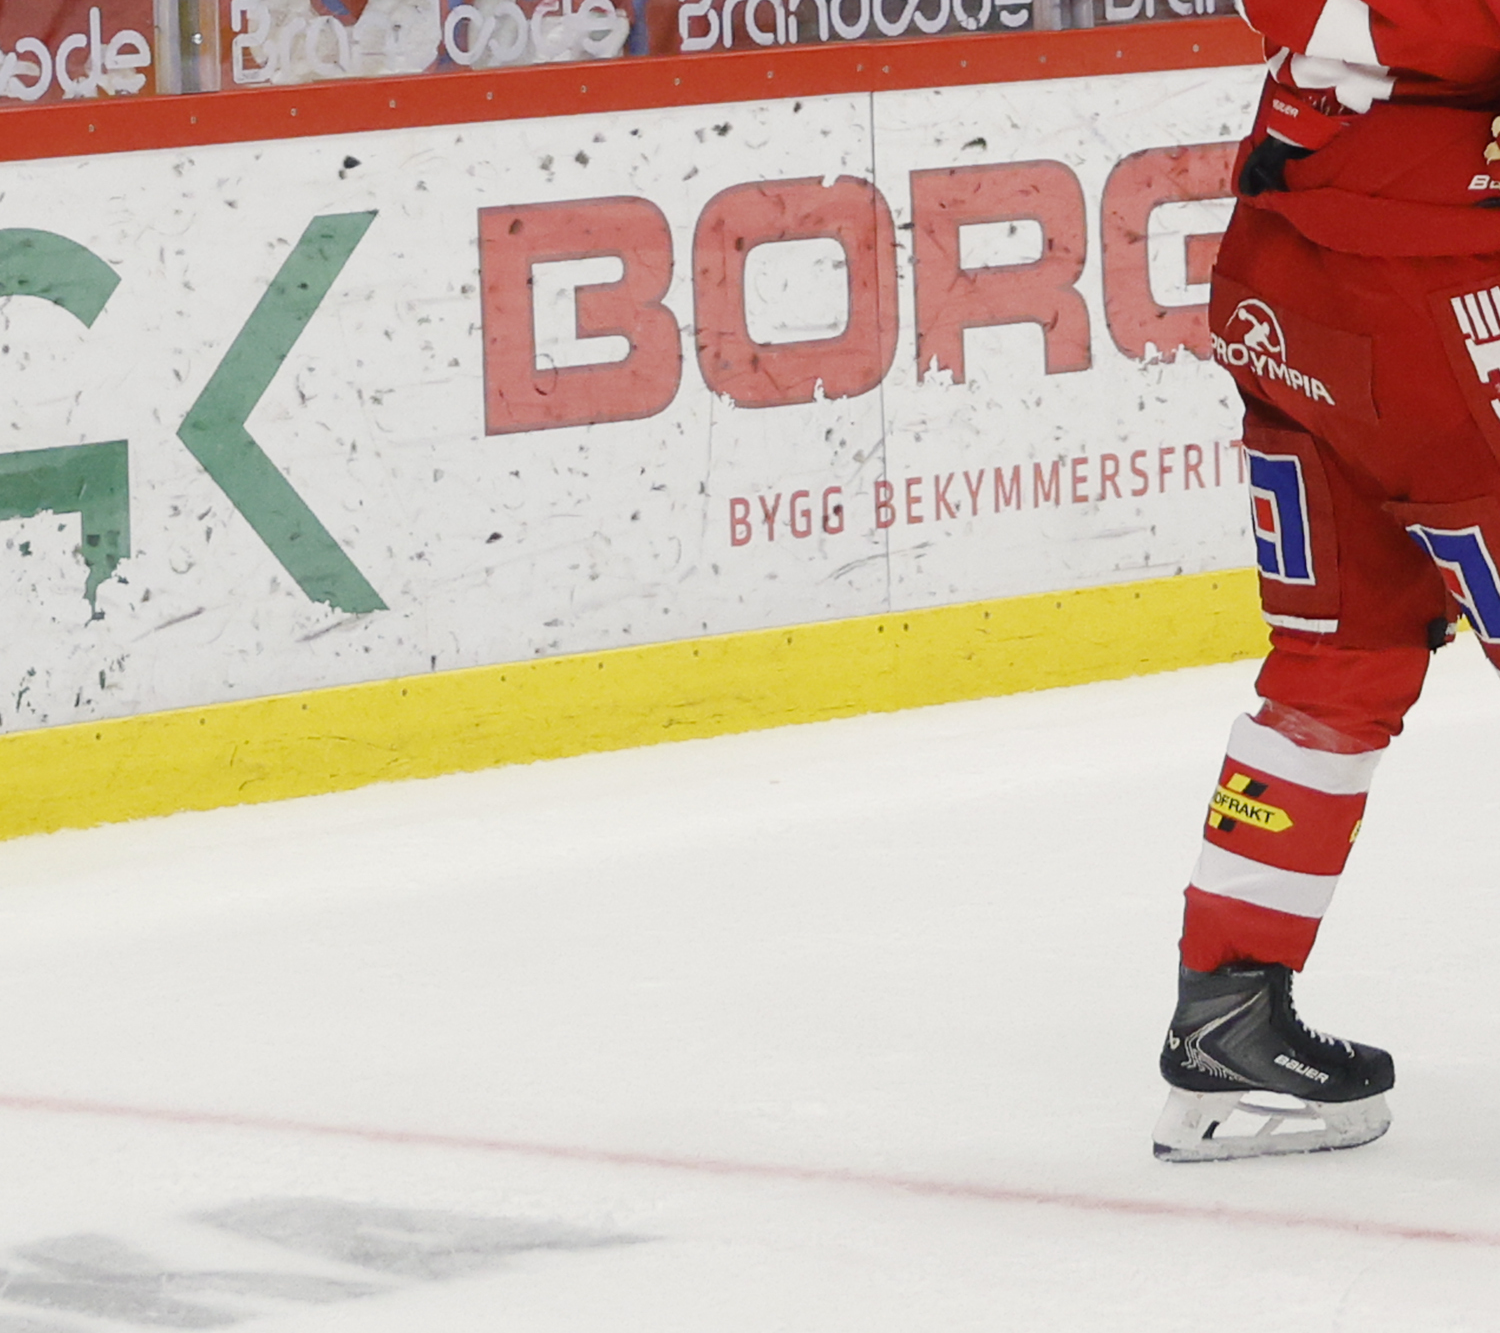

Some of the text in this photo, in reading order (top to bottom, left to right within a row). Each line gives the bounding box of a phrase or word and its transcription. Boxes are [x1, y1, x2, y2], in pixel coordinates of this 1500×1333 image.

[730, 437, 1249, 549] BYGG BEKYMMERSFRIT
[1273, 1053, 1330, 1085] BAUER
